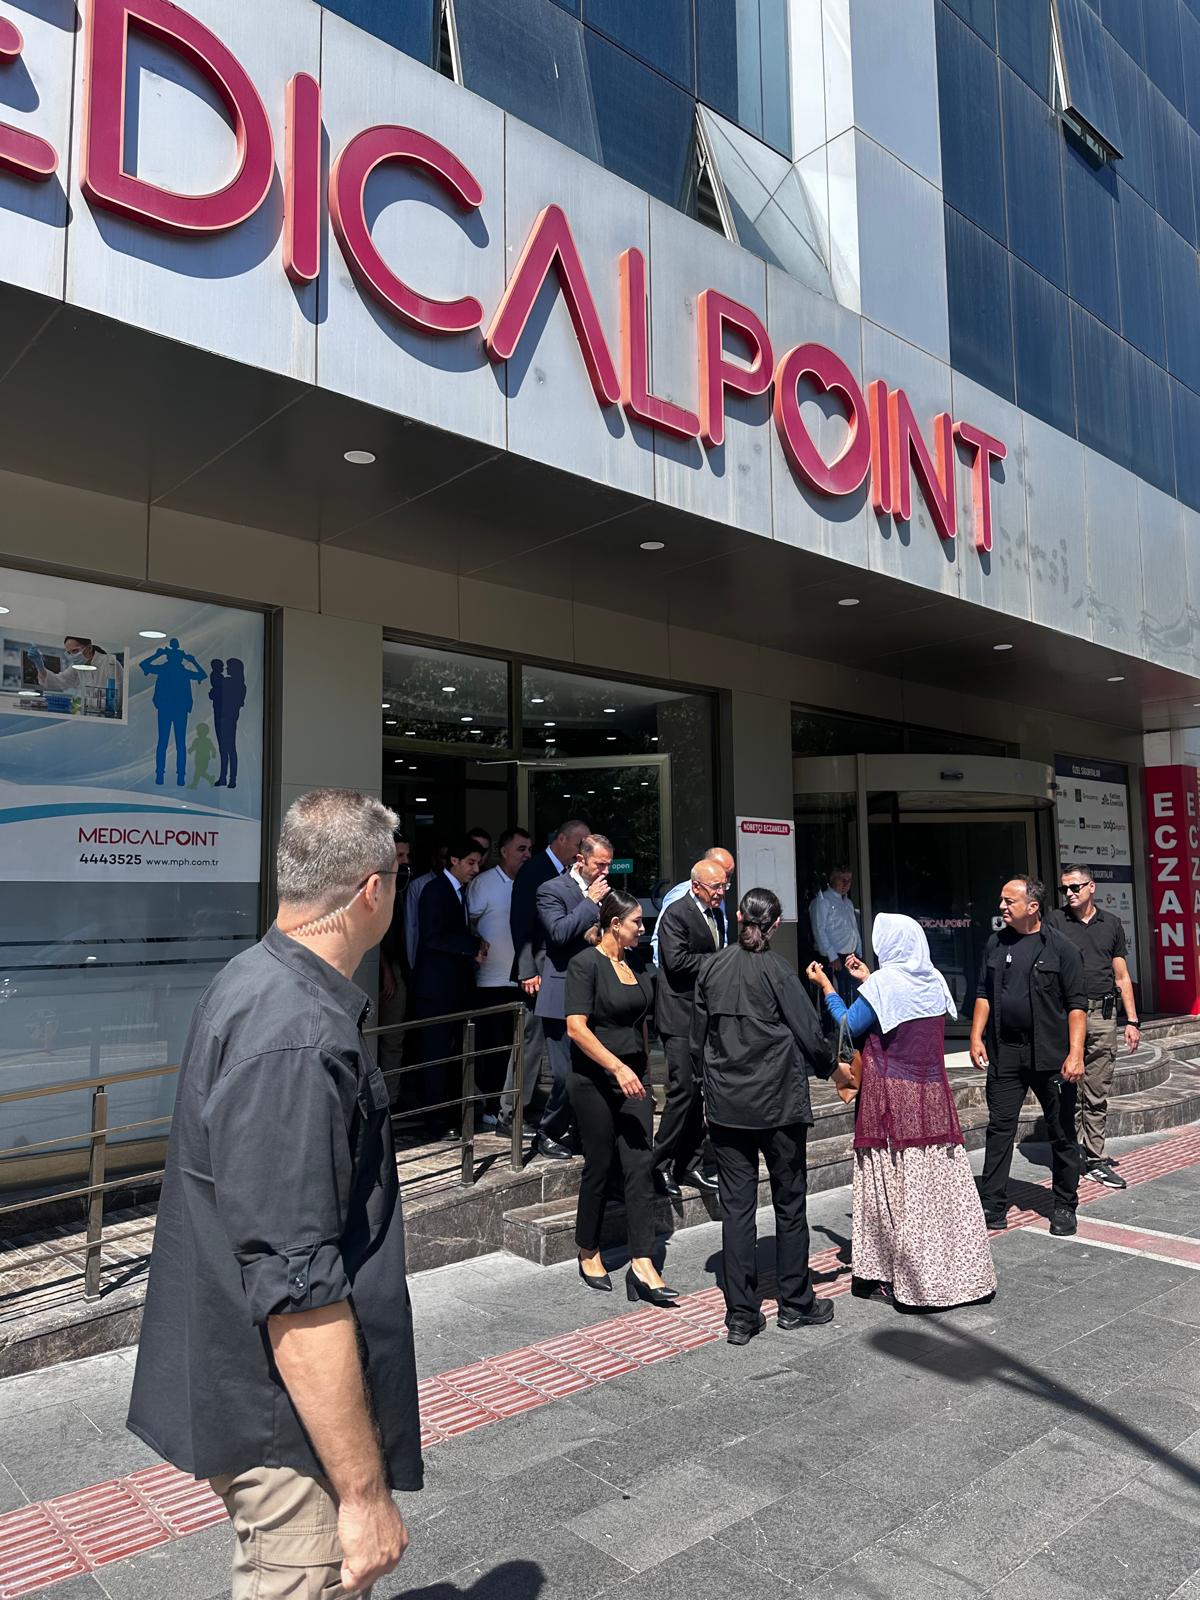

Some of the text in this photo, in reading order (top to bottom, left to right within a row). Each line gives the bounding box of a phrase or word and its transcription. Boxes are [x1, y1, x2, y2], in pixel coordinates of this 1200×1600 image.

[78, 827, 219, 846] MEDICALPOINT
[79, 853, 219, 867] 4443525 www.mph.com.tr
[1153, 792, 1185, 980] ECZANE
